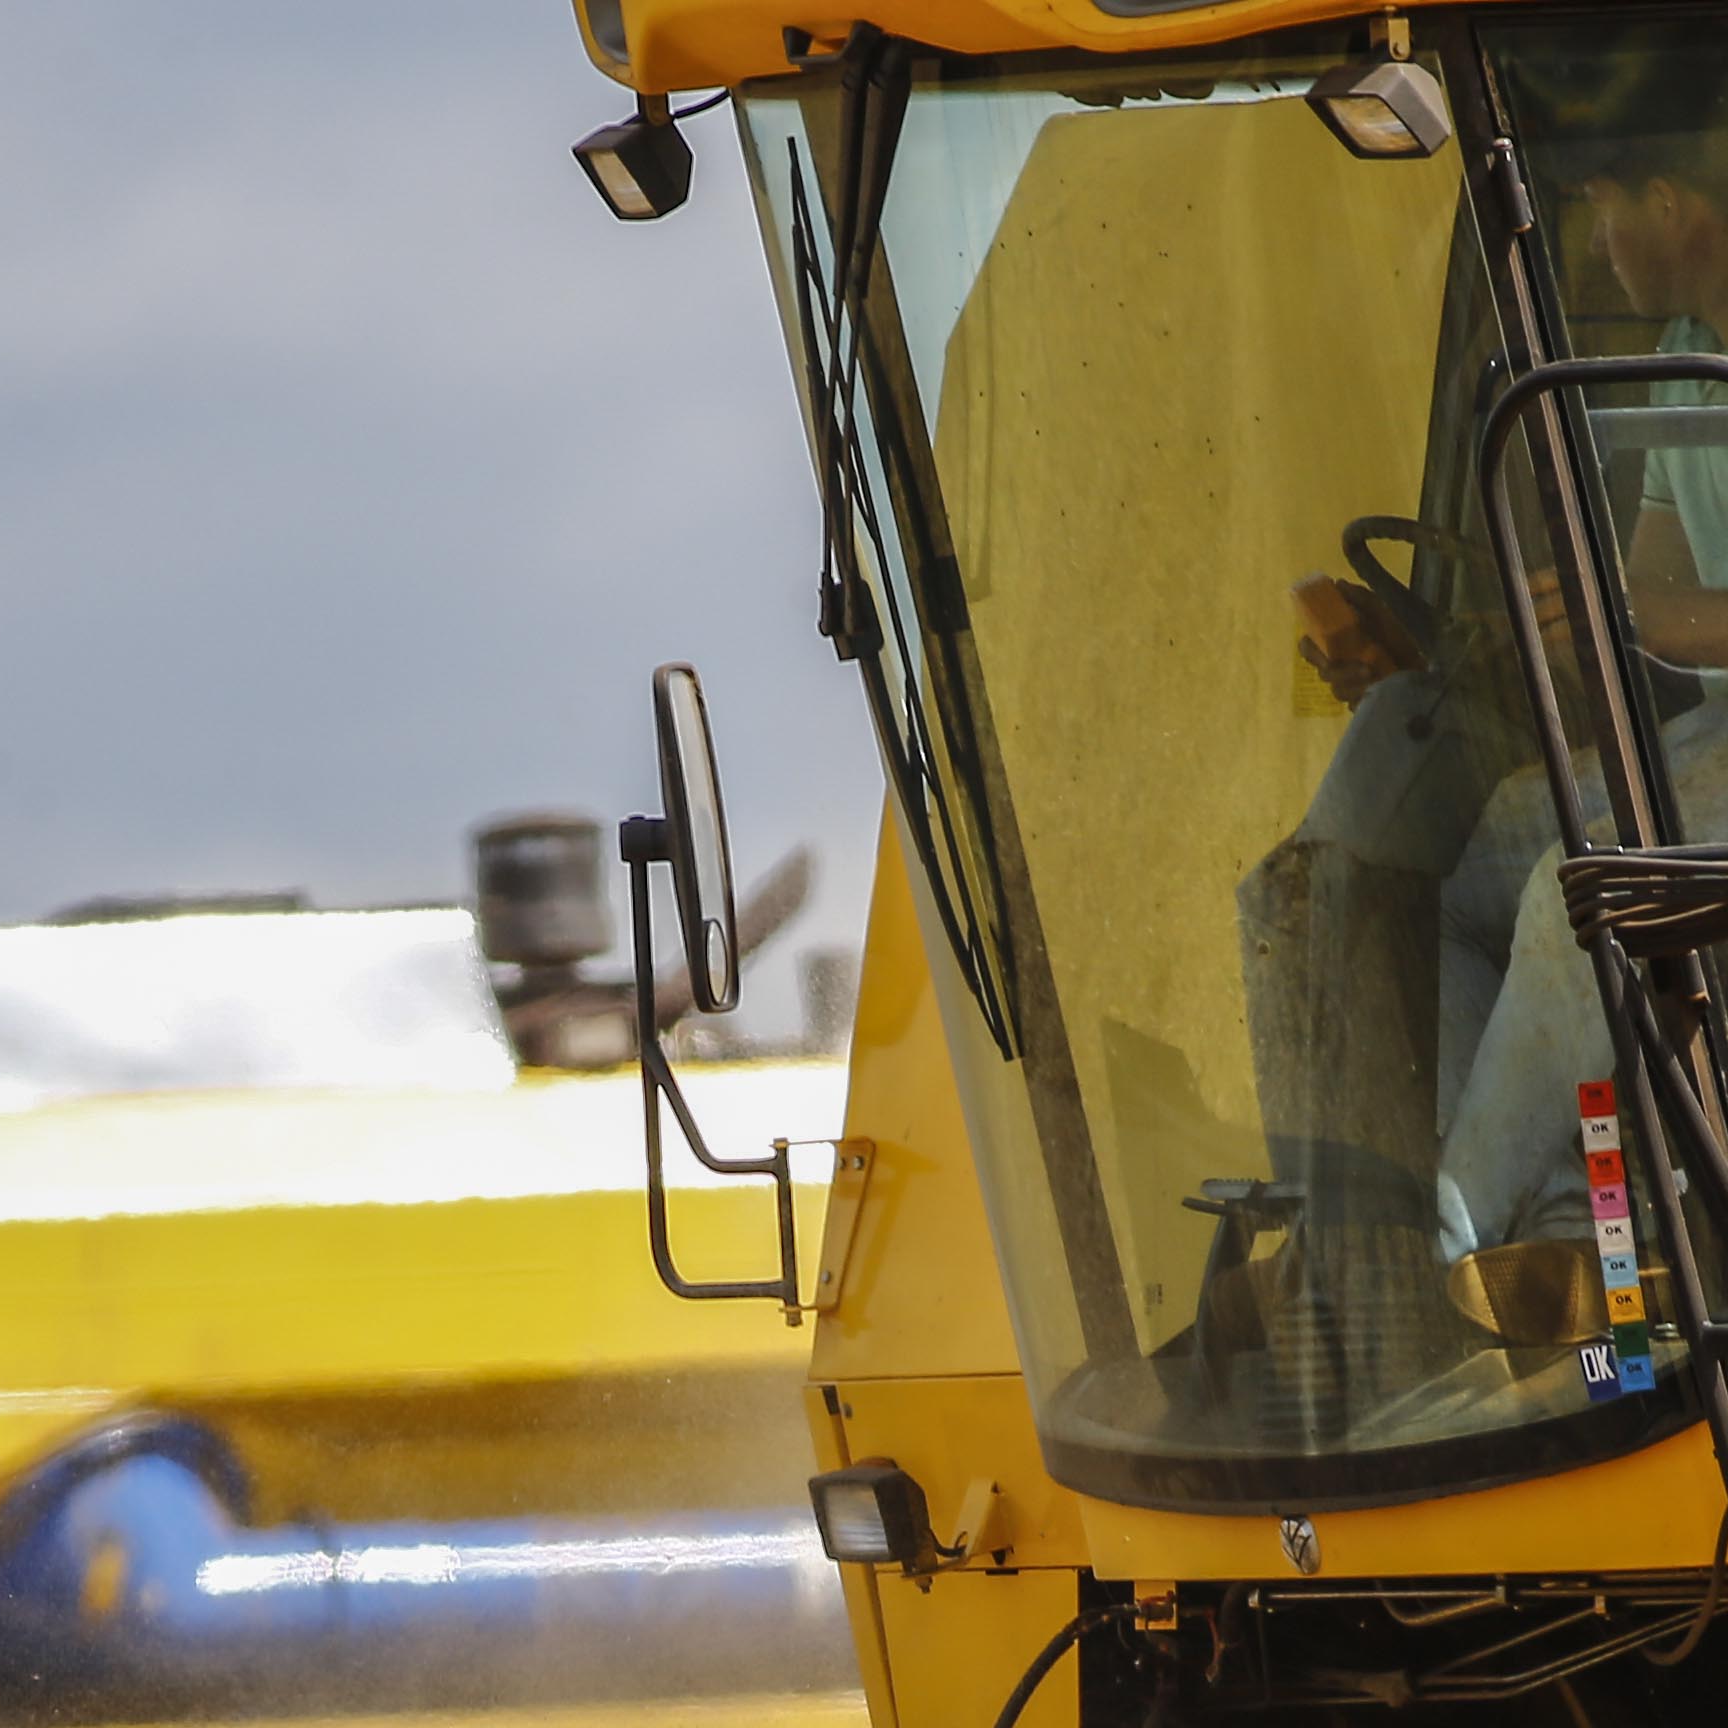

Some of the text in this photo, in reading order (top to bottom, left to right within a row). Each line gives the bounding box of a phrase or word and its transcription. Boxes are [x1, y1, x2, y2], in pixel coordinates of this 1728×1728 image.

[1591, 1123, 1609, 1133] OK
[1600, 1191, 1617, 1201] OK
[1605, 1226, 1623, 1236] OK
[1610, 1260, 1627, 1270] OK
[1615, 1295, 1633, 1305] OK
[1580, 1345, 1616, 1383] OK
